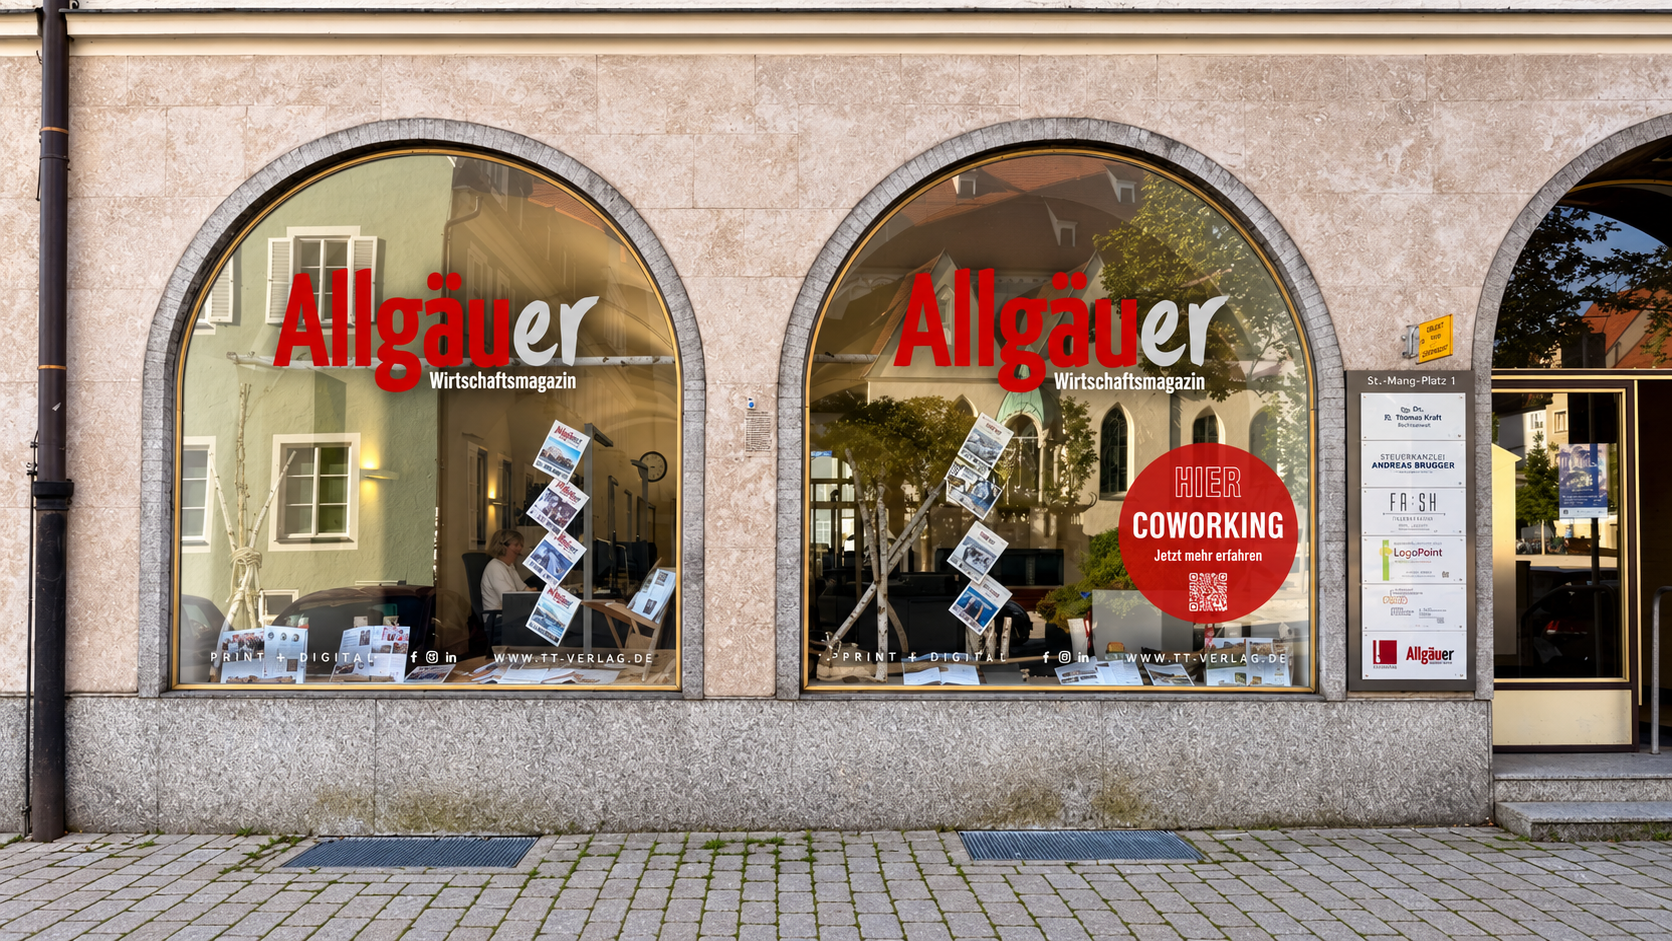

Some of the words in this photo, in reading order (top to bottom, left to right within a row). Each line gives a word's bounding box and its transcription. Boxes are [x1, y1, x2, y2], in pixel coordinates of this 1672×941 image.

[273, 268, 599, 393] Allgäuer
[893, 268, 1230, 393] Allgäuer
[429, 371, 577, 392] Wirtschaftsmagazin
[1054, 372, 1205, 393] Wirtschaftsmagazin
[1367, 376, 1447, 387] St.-Mang-Platz
[1450, 376, 1456, 385] 1
[1380, 453, 1446, 461] STEUERKANZLEI
[1371, 461, 1412, 469] ANDREAS
[1414, 461, 1455, 469] BRUGGER
[1175, 466, 1241, 498] HIER
[1132, 511, 1284, 539] COWORKING
[1154, 549, 1182, 562] Jetzt
[1185, 549, 1213, 562] mehr
[1215, 549, 1262, 562] erfahren
[1393, 547, 1443, 560] LogoPoint
[210, 651, 264, 662] PRINT
[300, 651, 374, 662] DIGITAL
[494, 653, 653, 663] WWW.TT-VERLAG.DE
[843, 651, 897, 662] PRINT
[930, 651, 1006, 662] DIGITAL
[1127, 653, 1286, 663] WWW.TT-VERLAG.DE
[1405, 645, 1455, 665] Allgäuer
